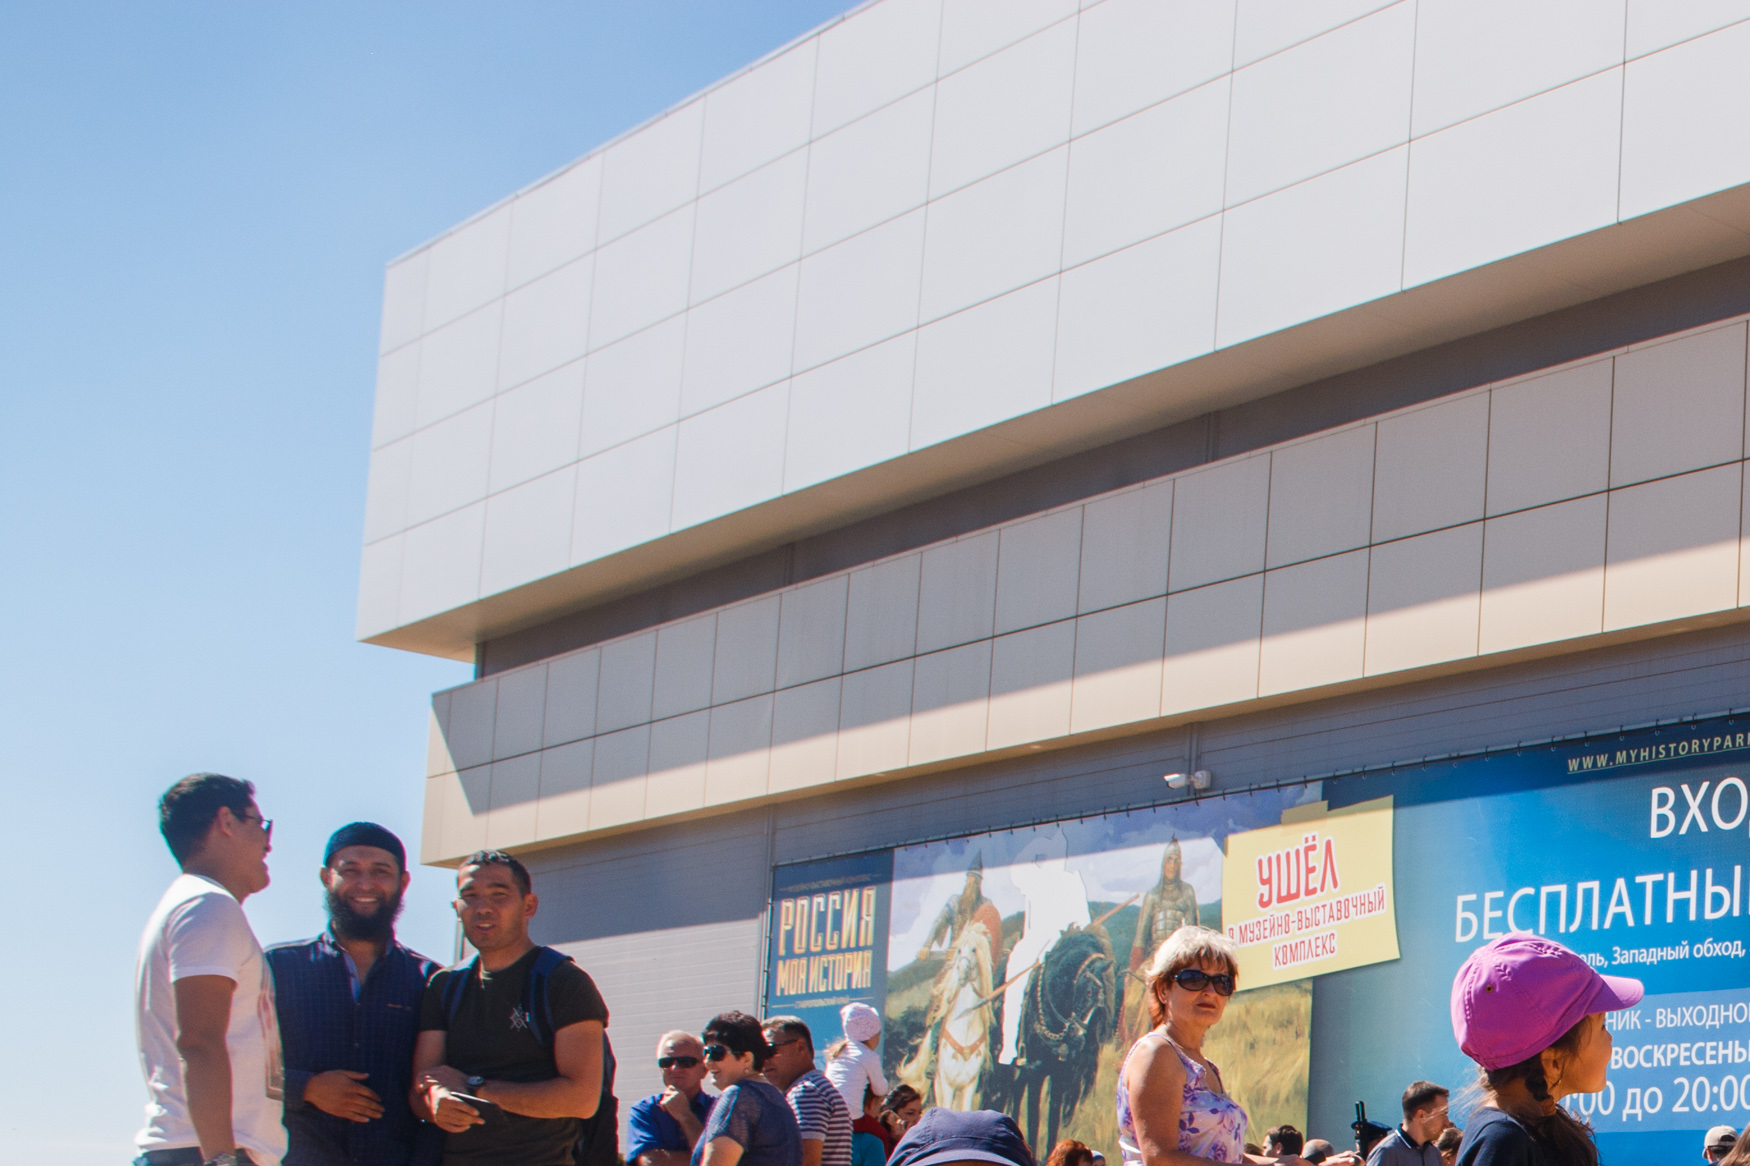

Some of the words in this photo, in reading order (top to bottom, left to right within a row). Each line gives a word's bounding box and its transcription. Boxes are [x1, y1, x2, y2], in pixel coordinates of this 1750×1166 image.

[1257, 834, 1339, 909] УШЁЛ
[778, 885, 877, 957] РОССИЯ
[1238, 885, 1385, 945] МУЗЕЙНО-ВЫСТАВОЧНЫЙ
[1274, 932, 1336, 967] КОМПЛЕКС
[1612, 941, 1690, 967] Западный
[1693, 937, 1746, 959] обход,
[775, 957, 808, 997] МОЯ
[808, 949, 873, 993] ИСТОРИЯ
[1605, 1009, 1642, 1031] НИК
[1622, 1087, 1663, 1122] до
